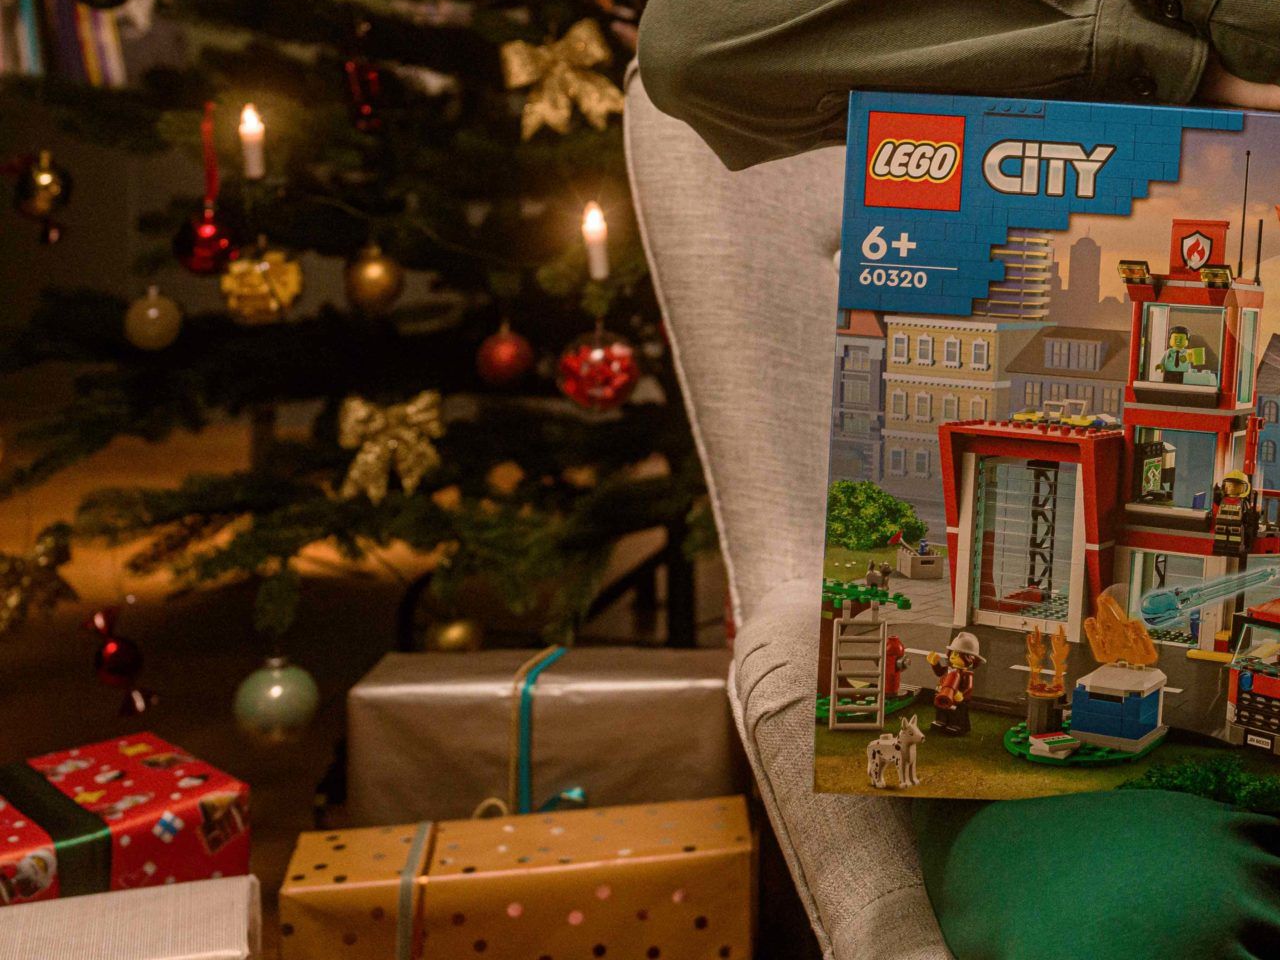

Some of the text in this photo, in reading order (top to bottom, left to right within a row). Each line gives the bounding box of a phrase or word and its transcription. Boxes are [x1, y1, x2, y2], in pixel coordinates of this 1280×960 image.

[872, 140, 958, 181] LEGO
[983, 140, 1116, 198] CITY
[861, 226, 917, 260] 6+
[859, 268, 928, 289] 60320
